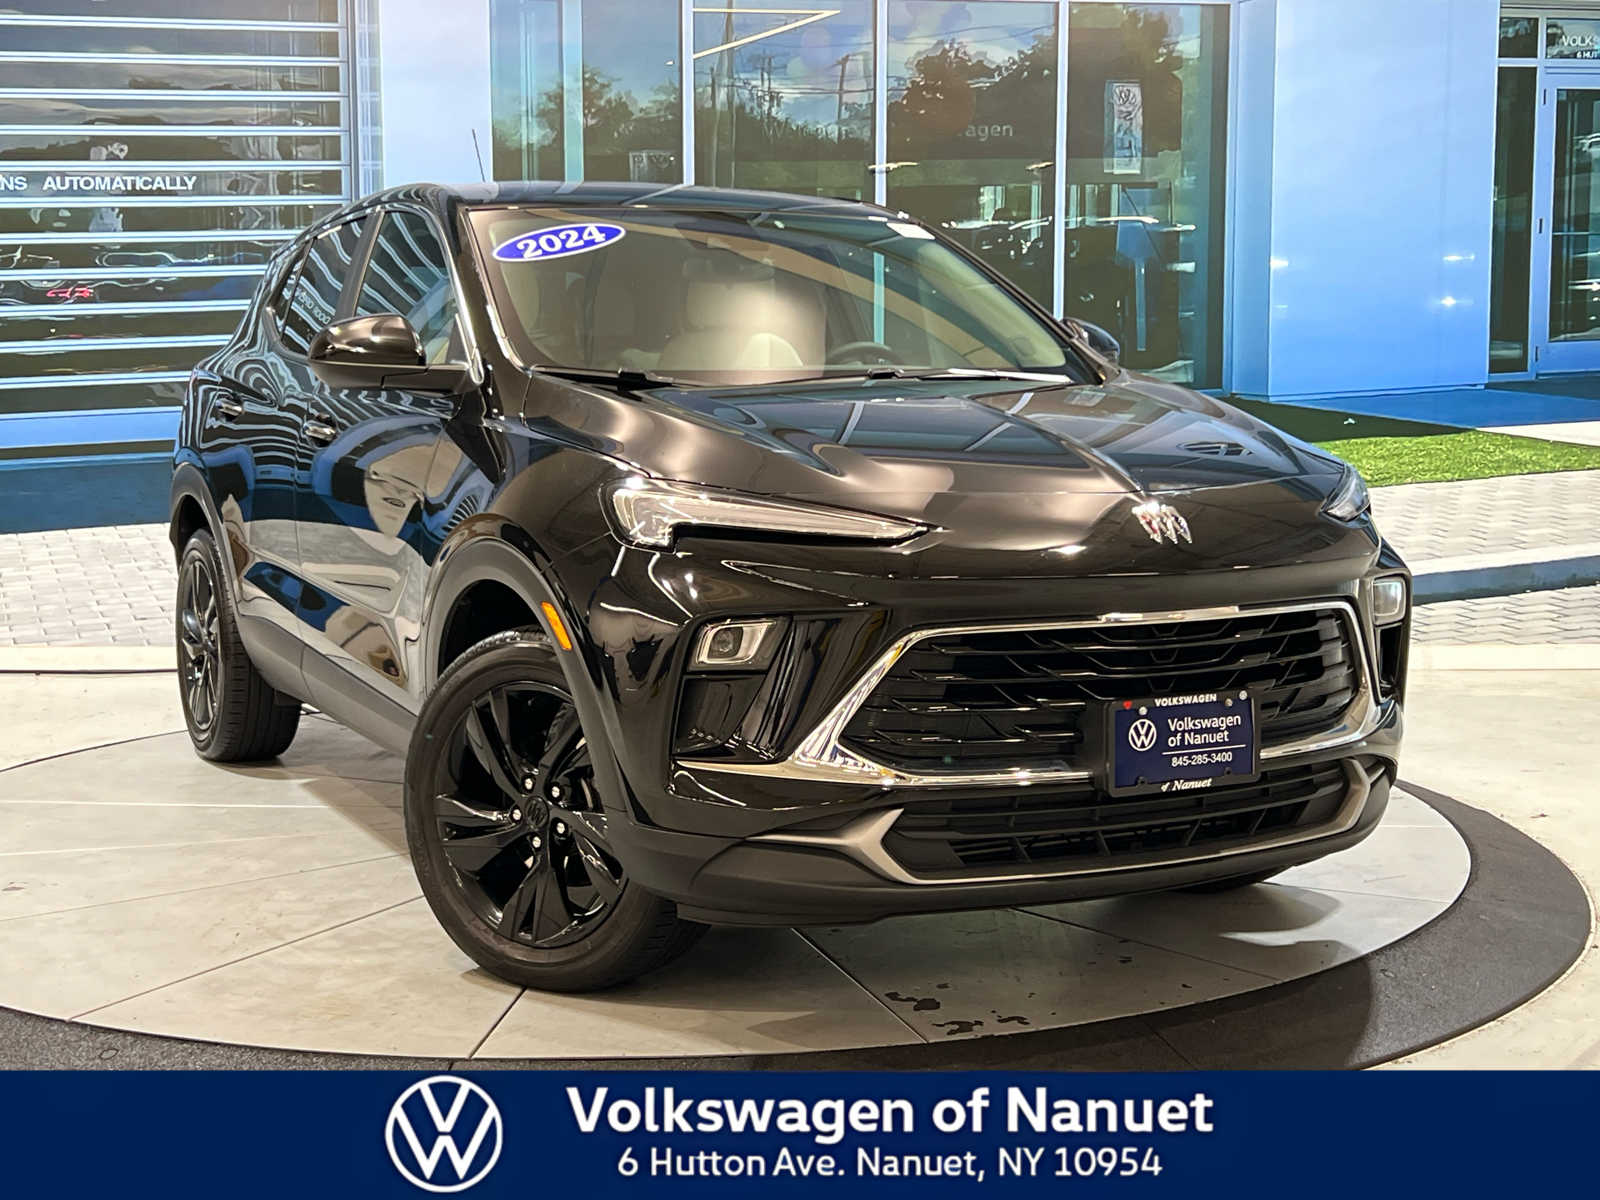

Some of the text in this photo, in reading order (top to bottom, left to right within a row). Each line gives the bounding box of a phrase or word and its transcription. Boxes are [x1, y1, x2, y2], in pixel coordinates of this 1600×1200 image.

[43, 175, 197, 191] AUTOMATICALLY
[516, 225, 606, 259] 2024
[1154, 693, 1217, 707] VOLKSWAGEN
[1168, 715, 1241, 732] Volkswagen
[1168, 730, 1230, 747] of Nanuet
[1171, 752, 1233, 768] 845-285-3400
[1172, 778, 1212, 791] Nanuet
